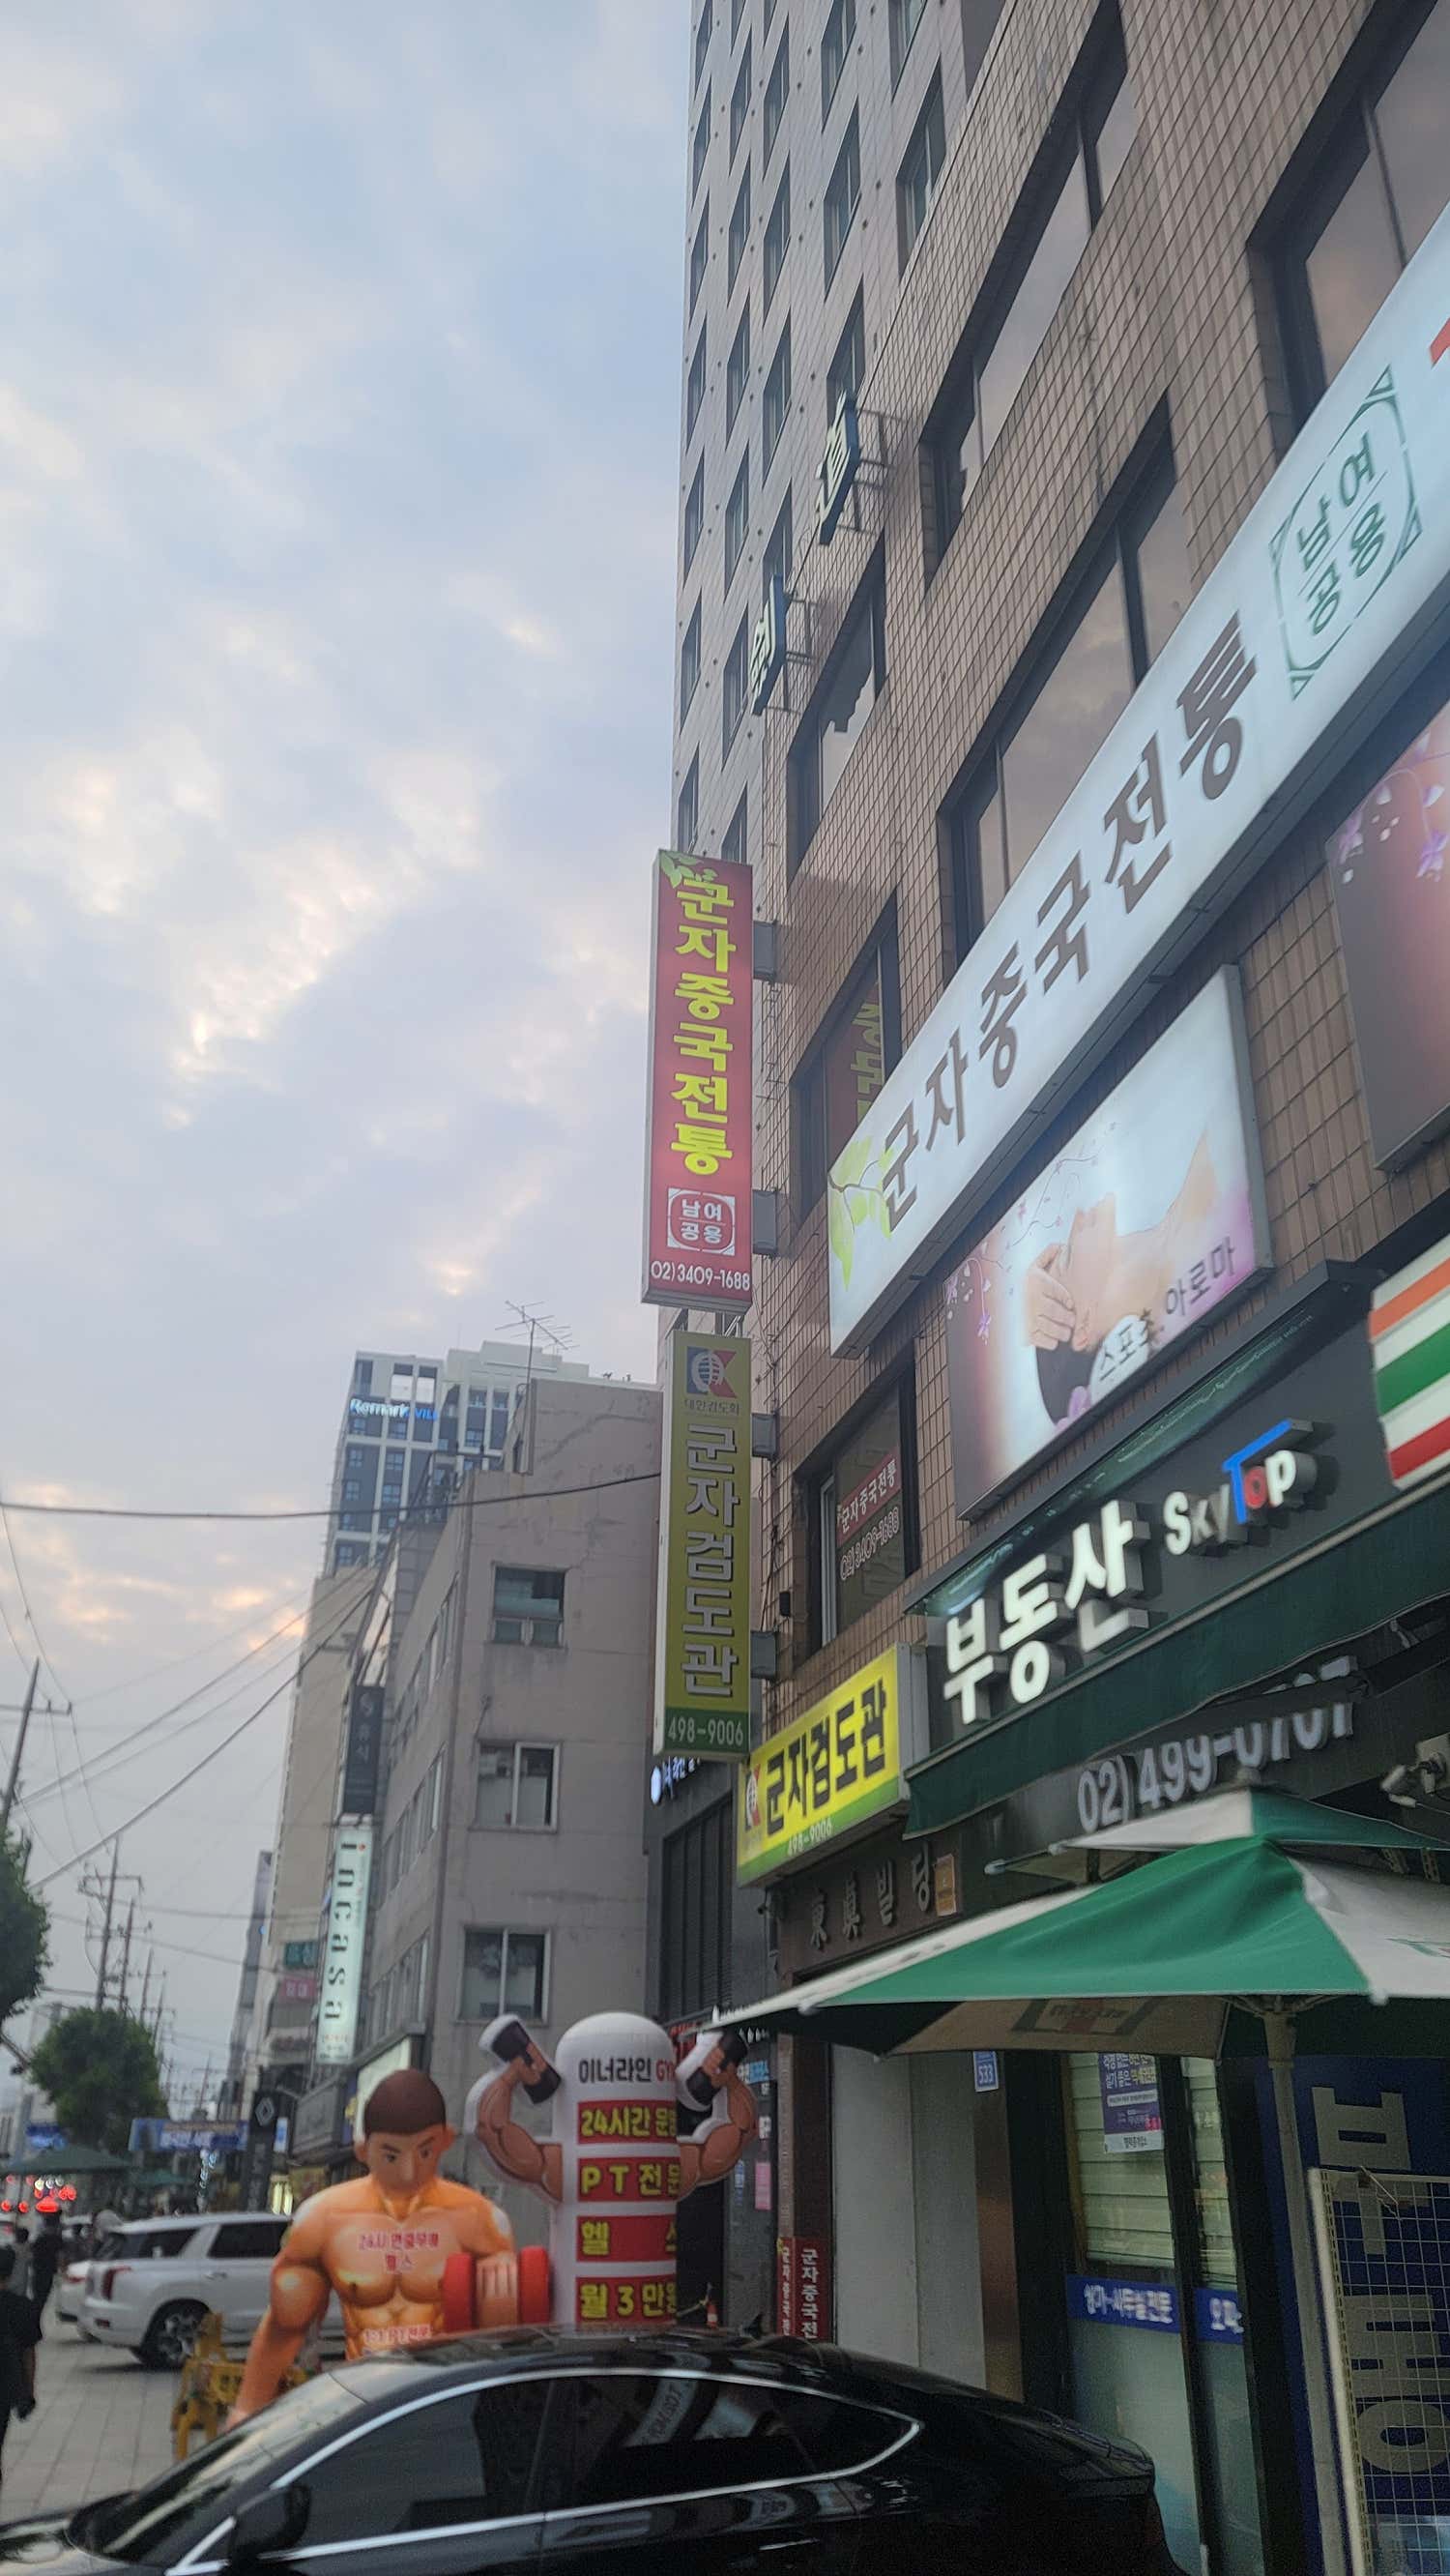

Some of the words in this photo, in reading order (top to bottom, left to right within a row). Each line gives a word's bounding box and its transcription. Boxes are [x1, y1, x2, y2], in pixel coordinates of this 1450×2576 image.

[1296, 429, 1376, 572] 남여
[1305, 502, 1386, 636] 공용
[881, 610, 1260, 1235] 군자중국전통
[670, 875, 737, 1176] 군자중국전통
[680, 1221, 724, 1245] 공용
[681, 1196, 723, 1223] 남여
[650, 1260, 751, 1292] 02)3409-1688
[1165, 1236, 1236, 1316] 아로마
[841, 1458, 897, 1536] 군자중국전통
[682, 1422, 741, 1698] 군자검도관
[942, 1499, 1141, 1724] 부동산
[667, 1715, 744, 1747] 498-9006
[766, 1677, 887, 1837] 군자검도관
[578, 2057, 652, 2084] 이너라인
[580, 2106, 652, 2138] 24시간
